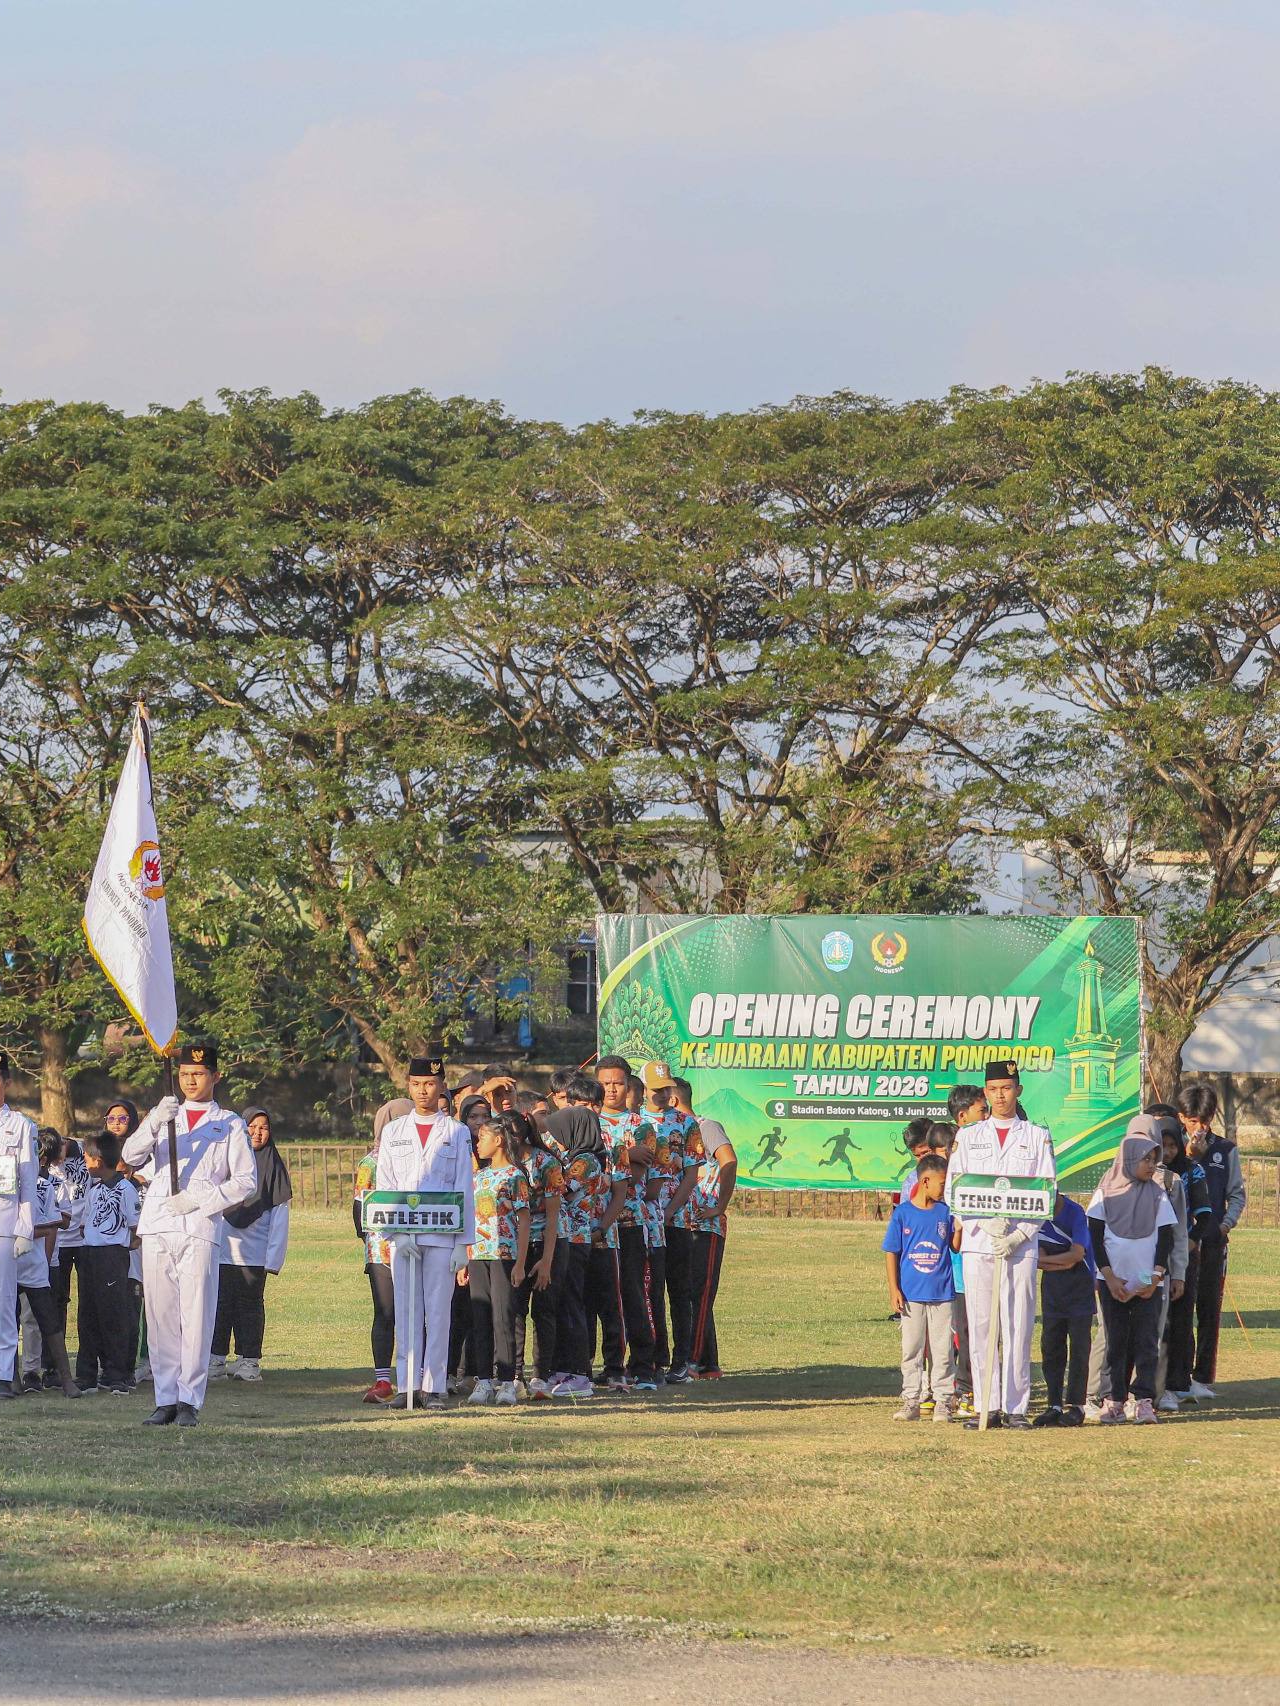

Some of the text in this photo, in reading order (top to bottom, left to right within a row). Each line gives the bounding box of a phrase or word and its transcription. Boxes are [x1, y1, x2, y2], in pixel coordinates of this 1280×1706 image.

[118, 873, 149, 910] INDONESIA
[119, 905, 148, 939] PONOROGO
[874, 965, 904, 974] INDONESIA
[688, 992, 1040, 1040] OPENING CEREMONY
[679, 1042, 807, 1070] KEJUARAAN
[812, 1043, 936, 1070] KABUPATEN
[793, 1075, 929, 1097] TAHUN 2026
[792, 1105, 947, 1118] Stadion Batoro Katong, 18 Juni 2026
[960, 1194, 1045, 1211] TENIS MEJA
[372, 1210, 454, 1226] ATLETIK
